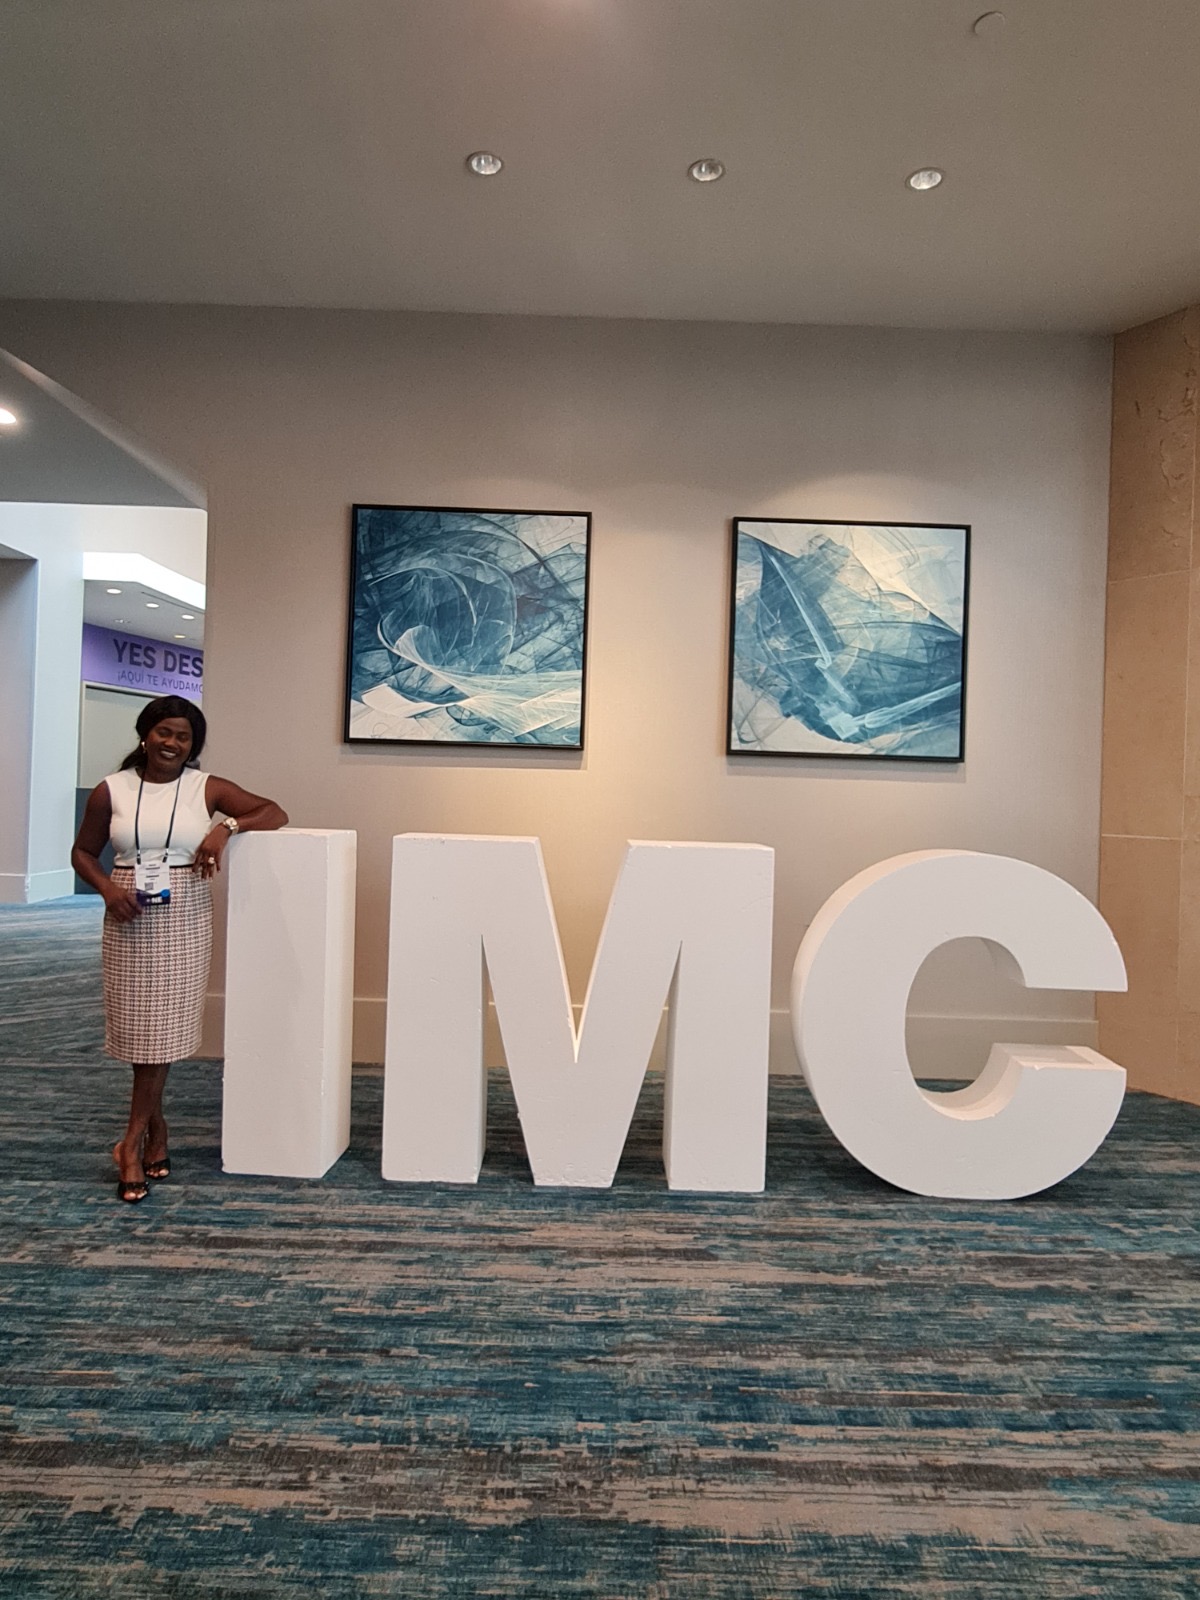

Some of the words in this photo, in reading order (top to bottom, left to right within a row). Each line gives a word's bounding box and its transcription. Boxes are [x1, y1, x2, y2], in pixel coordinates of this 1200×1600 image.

[113, 638, 156, 669] YES
[147, 674, 158, 686] TE
[221, 827, 1128, 1201] IMC
